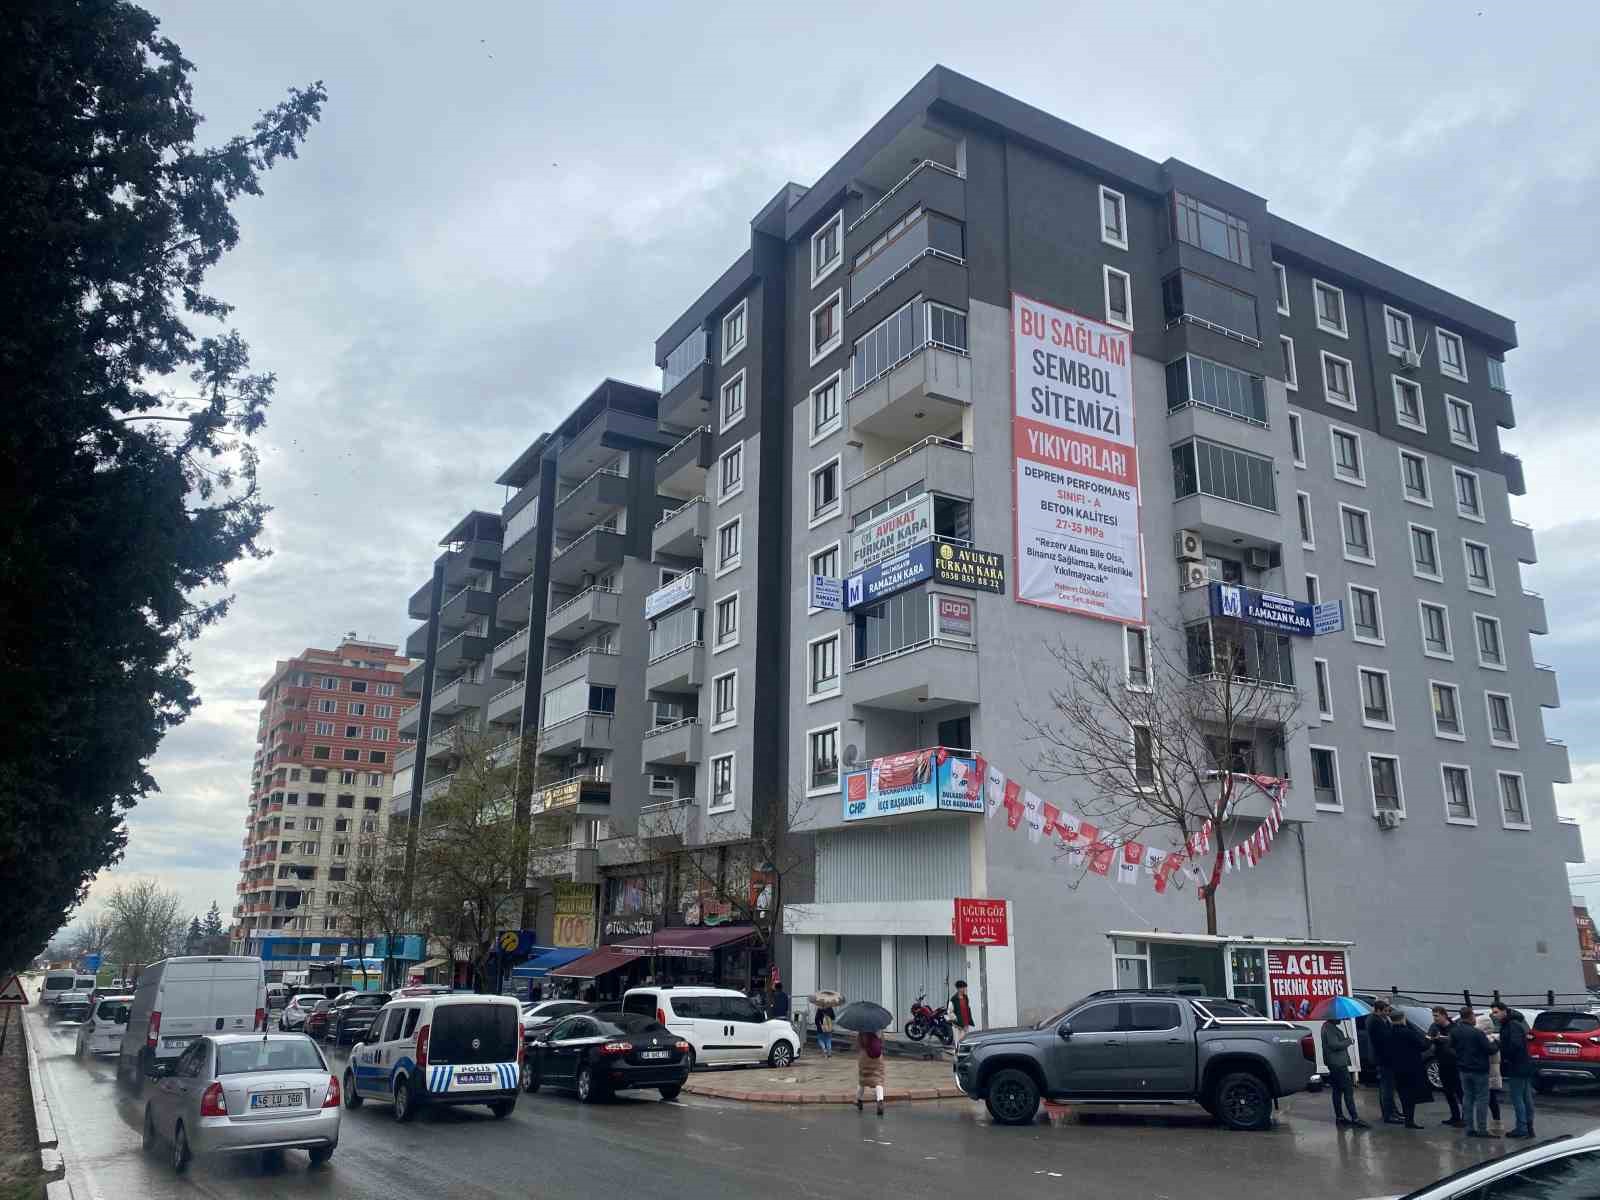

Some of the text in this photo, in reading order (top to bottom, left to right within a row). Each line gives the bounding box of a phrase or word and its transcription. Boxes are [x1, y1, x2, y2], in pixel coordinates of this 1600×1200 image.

[1021, 307, 1126, 367] BU SAĞLAM
[1032, 349, 1117, 398] SEMBOL
[1031, 385, 1120, 435] SİTEMİZİ
[1027, 428, 1127, 476] YIKIYORLAR!
[1024, 466, 1130, 501] DEPREM PERFORMANS
[1056, 489, 1086, 504] SINIFI
[1093, 498, 1101, 507] A
[876, 511, 915, 538] AVUKAT
[1040, 500, 1118, 527] BETON KALİTESİ
[1056, 519, 1104, 538] 27-35 MPa
[854, 532, 894, 562] FURKAN
[897, 518, 928, 541] KARA
[959, 550, 998, 567] AVUKAT
[1068, 544, 1088, 556] Alanı
[1090, 548, 1104, 559] Bile
[869, 573, 902, 593] RAMAZAN
[903, 562, 924, 580] KARA
[935, 558, 1003, 580] FURKAN KARA
[1097, 562, 1133, 578] Kesinlikle
[850, 584, 860, 604] M
[1248, 605, 1288, 623] RAMAZAN
[1288, 613, 1312, 628] KARA
[848, 801, 867, 816] CHP
[962, 904, 1005, 917] UĞUR GÖZ
[971, 924, 997, 937] ACİL
